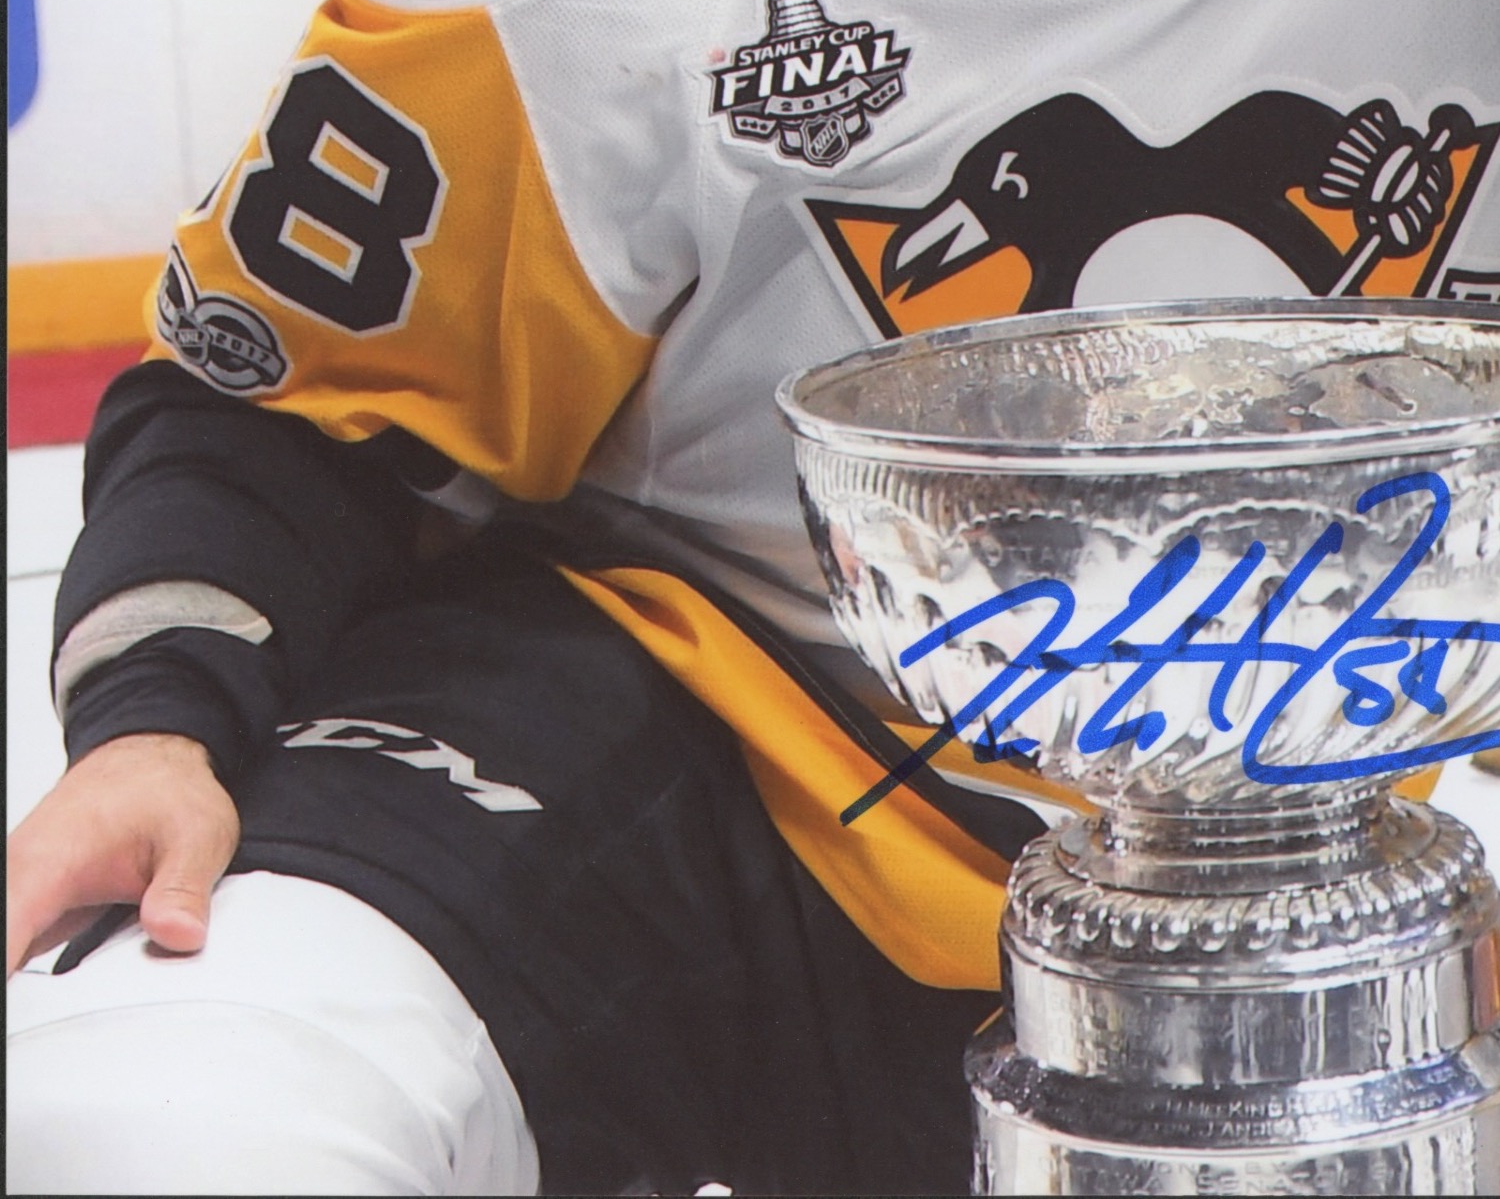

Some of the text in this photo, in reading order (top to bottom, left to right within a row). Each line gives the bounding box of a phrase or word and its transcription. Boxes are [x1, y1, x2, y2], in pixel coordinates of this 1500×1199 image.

[739, 25, 871, 66] STANLEY CUP
[721, 37, 903, 107] FINAL
[780, 85, 851, 113] 2017
[813, 120, 840, 154] NHL
[195, 54, 449, 339] 8
[215, 332, 270, 363] 2017
[276, 718, 544, 812] CCM
